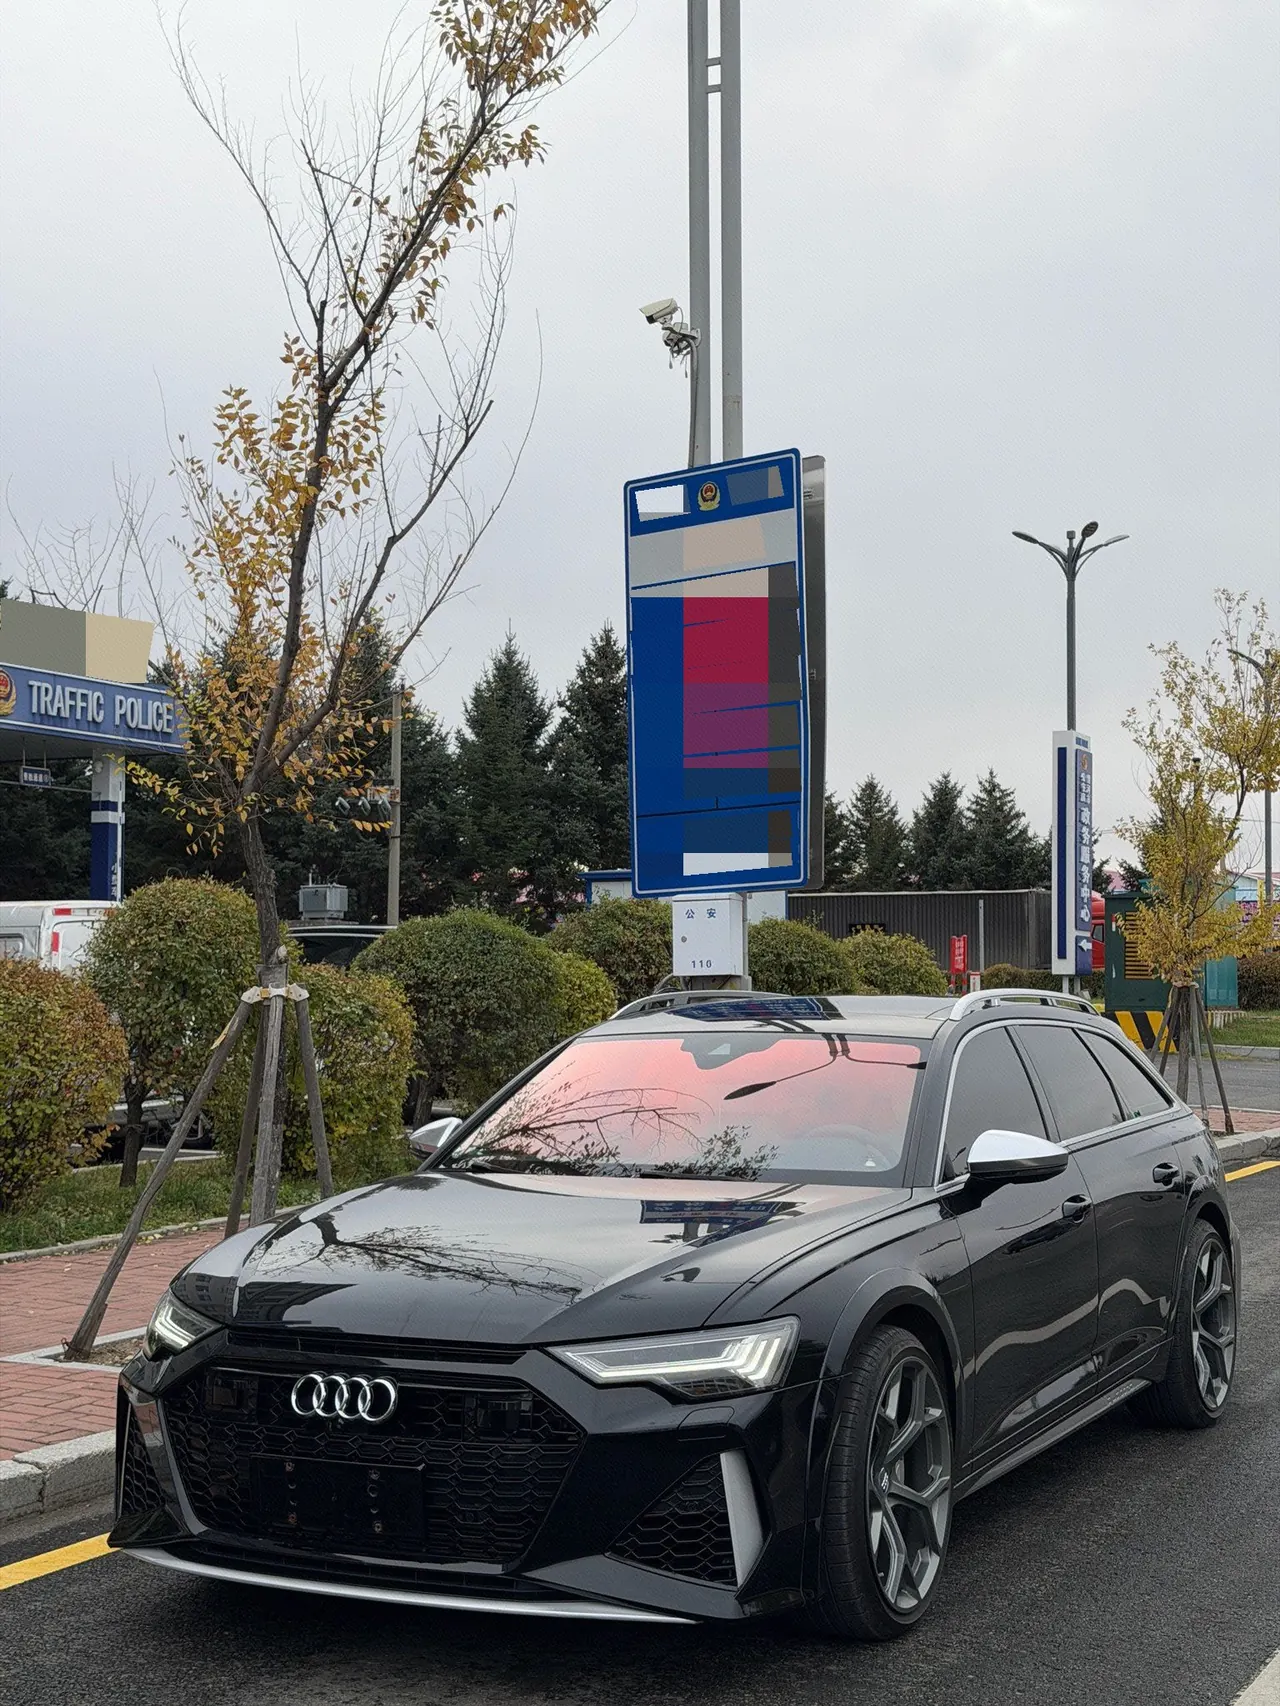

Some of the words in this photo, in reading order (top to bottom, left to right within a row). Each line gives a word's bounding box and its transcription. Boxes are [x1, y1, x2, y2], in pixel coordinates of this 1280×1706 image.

[28, 680, 104, 723] TRAFFIC
[115, 695, 173, 733] POLICE
[685, 908, 717, 919] 公安
[691, 959, 712, 968] 110
